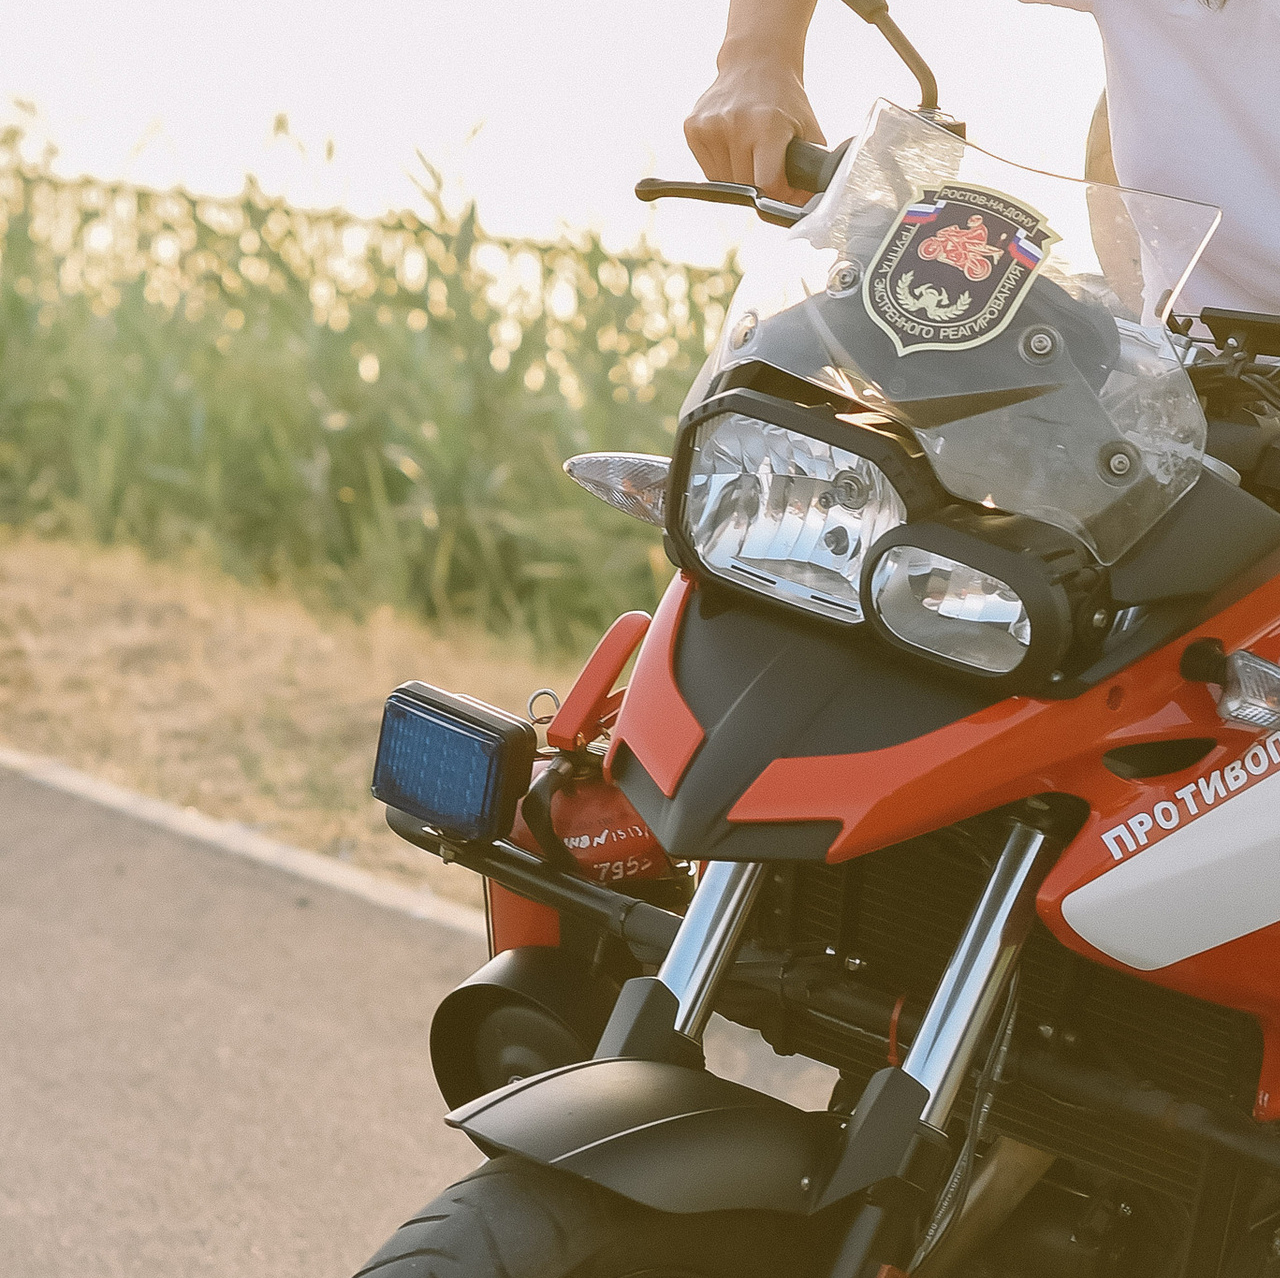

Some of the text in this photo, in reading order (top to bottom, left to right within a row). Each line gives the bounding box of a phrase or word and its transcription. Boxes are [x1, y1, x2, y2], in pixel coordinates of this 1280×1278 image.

[941, 188, 1037, 227] РОСТОВ-НА-ДОНУ
[874, 224, 1025, 340] ГРУППА ЭКСТРЕННОГО РЕАГИРОВАНИЯ
